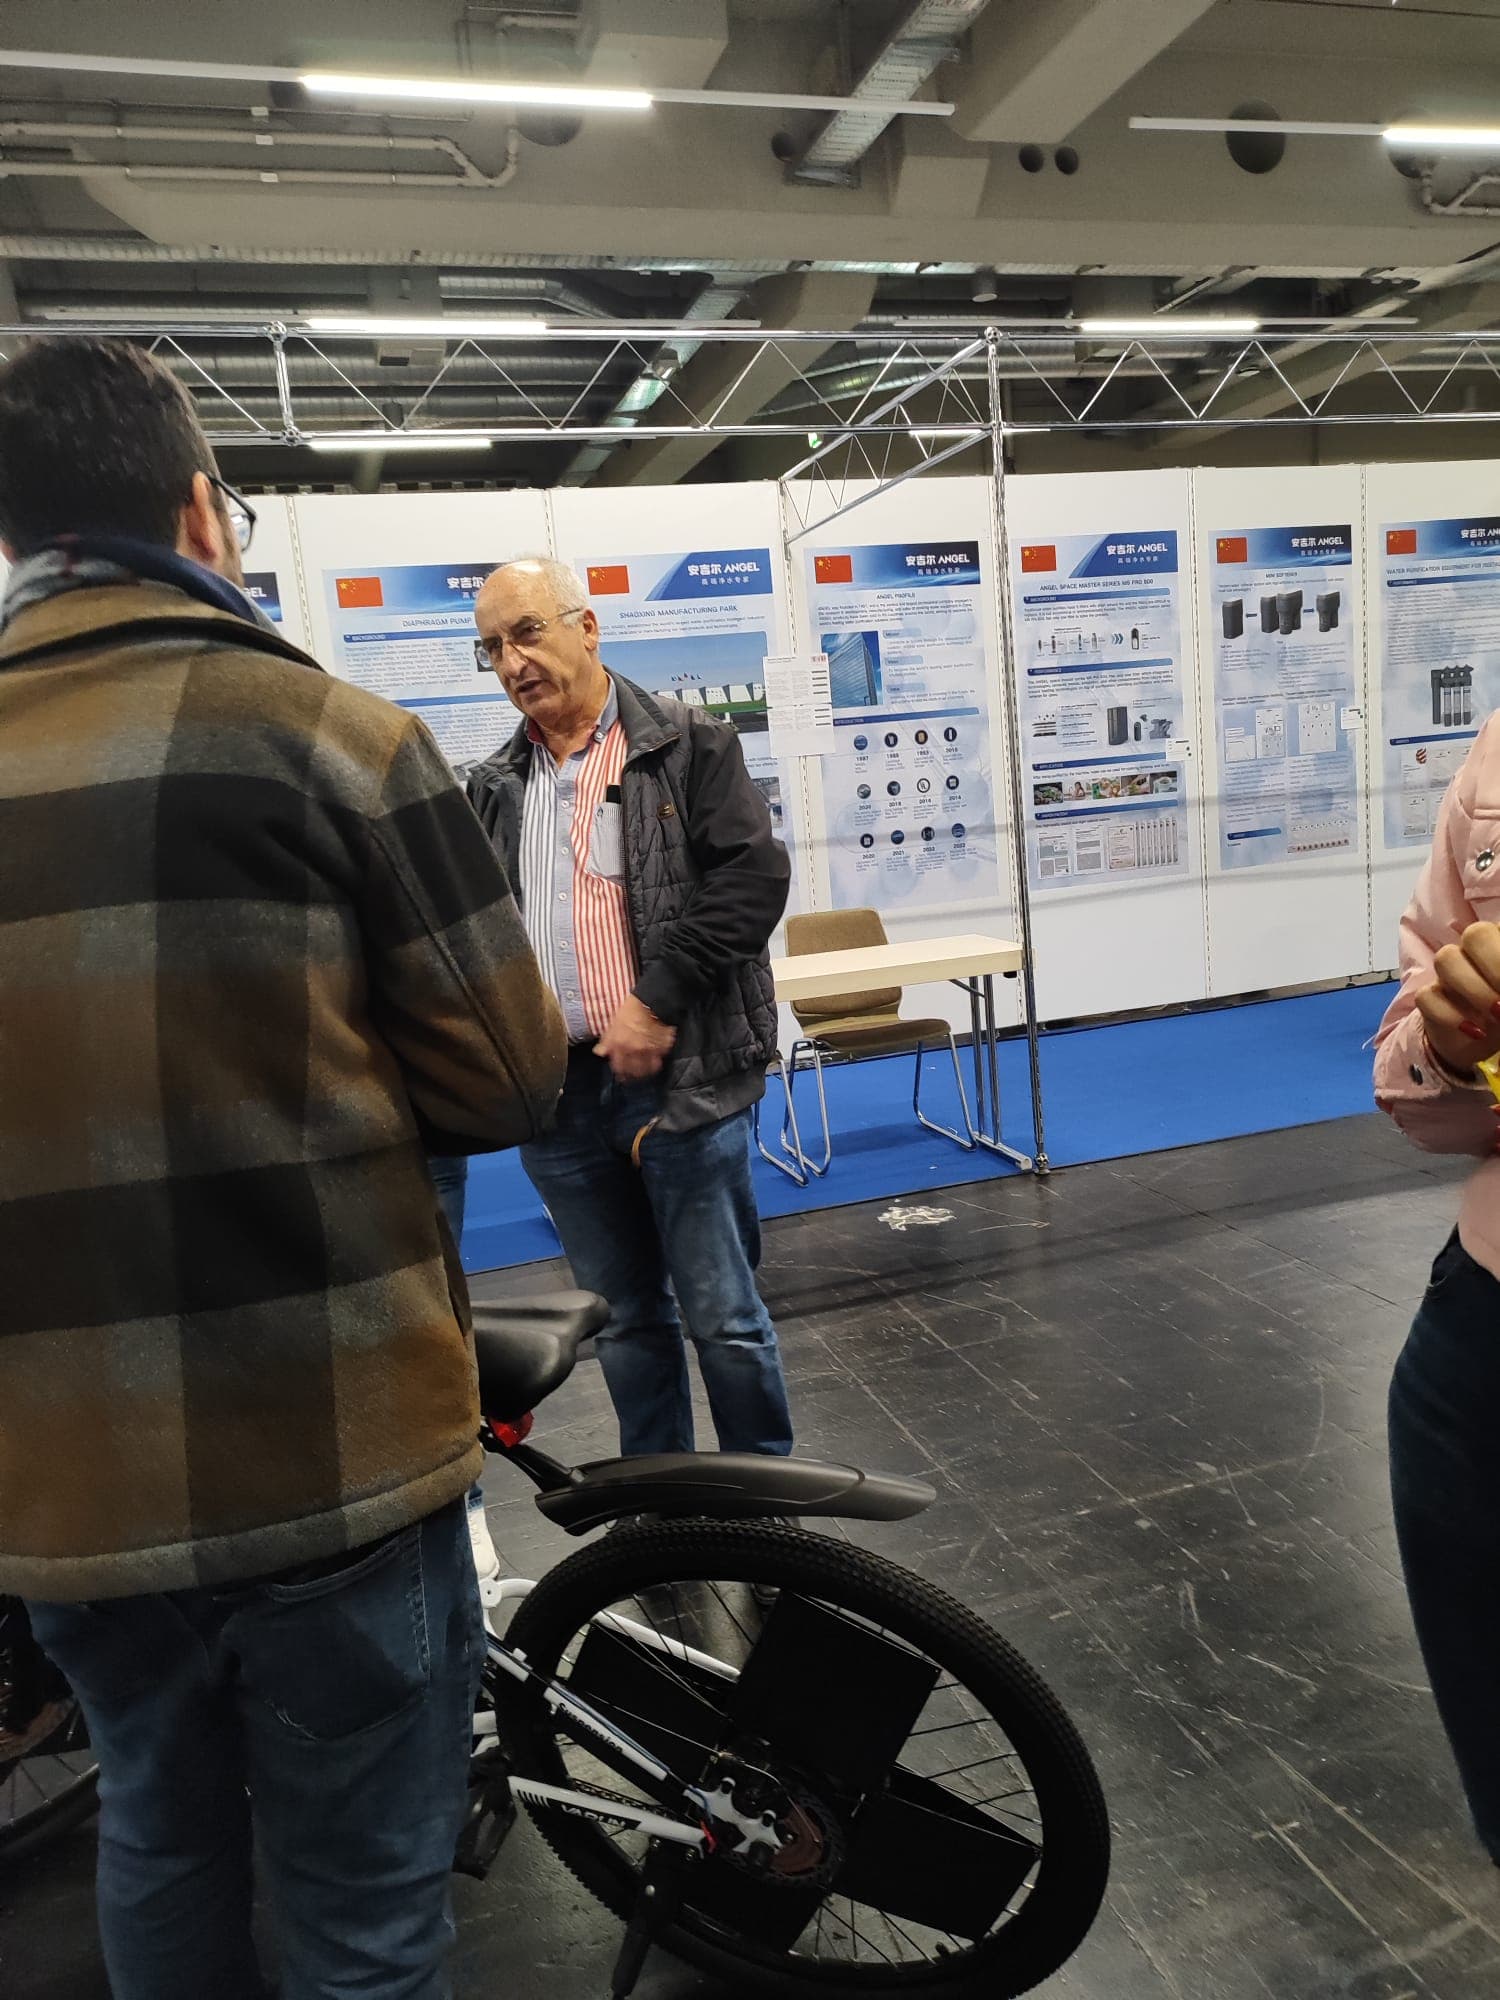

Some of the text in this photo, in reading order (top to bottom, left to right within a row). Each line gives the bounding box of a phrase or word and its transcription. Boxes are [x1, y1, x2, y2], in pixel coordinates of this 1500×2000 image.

[1291, 536, 1345, 548] 安吉尔 ANGEL
[1106, 542, 1169, 556] 安吉尔 ANGEL
[905, 553, 971, 567] 安吉尔 ANGEL
[687, 561, 760, 577] 安吉尔 ANGEL
[242, 586, 268, 598] GEL
[1039, 583, 1059, 592] ANGEL
[657, 606, 719, 617] MANUFACTURING
[719, 604, 738, 613] PARK
[402, 616, 472, 628] DIAPHRAGM PUMP
